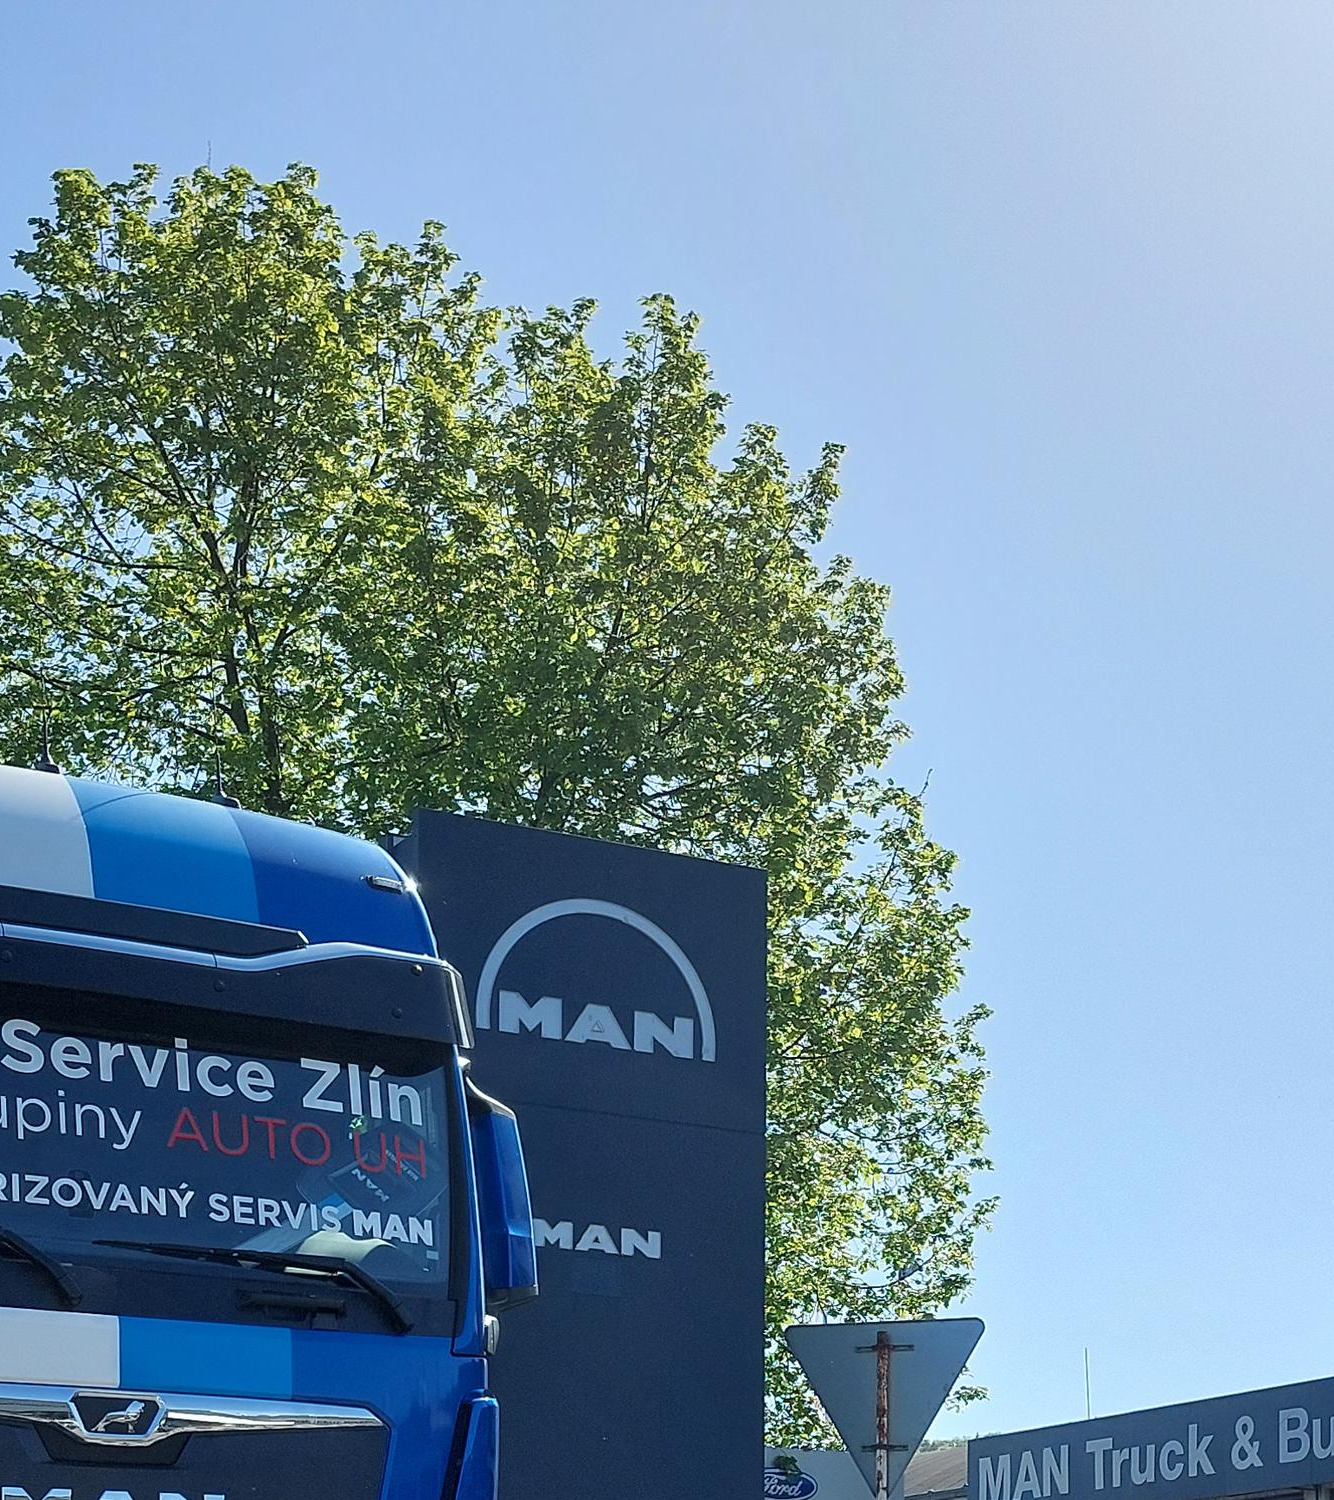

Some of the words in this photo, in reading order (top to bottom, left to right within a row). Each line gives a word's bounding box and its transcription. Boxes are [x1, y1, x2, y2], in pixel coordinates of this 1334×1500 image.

[498, 990, 695, 1060] MAN
[0, 1019, 275, 1103] Service
[299, 1057, 424, 1127] Zlín
[167, 1106, 332, 1167] AUTO
[353, 1130, 427, 1180] UH
[208, 1193, 343, 1233] SERVIS
[352, 1209, 434, 1247] MAN
[533, 1218, 662, 1260] MAN
[1085, 1422, 1218, 1491] Truck
[1230, 1414, 1264, 1471] &
